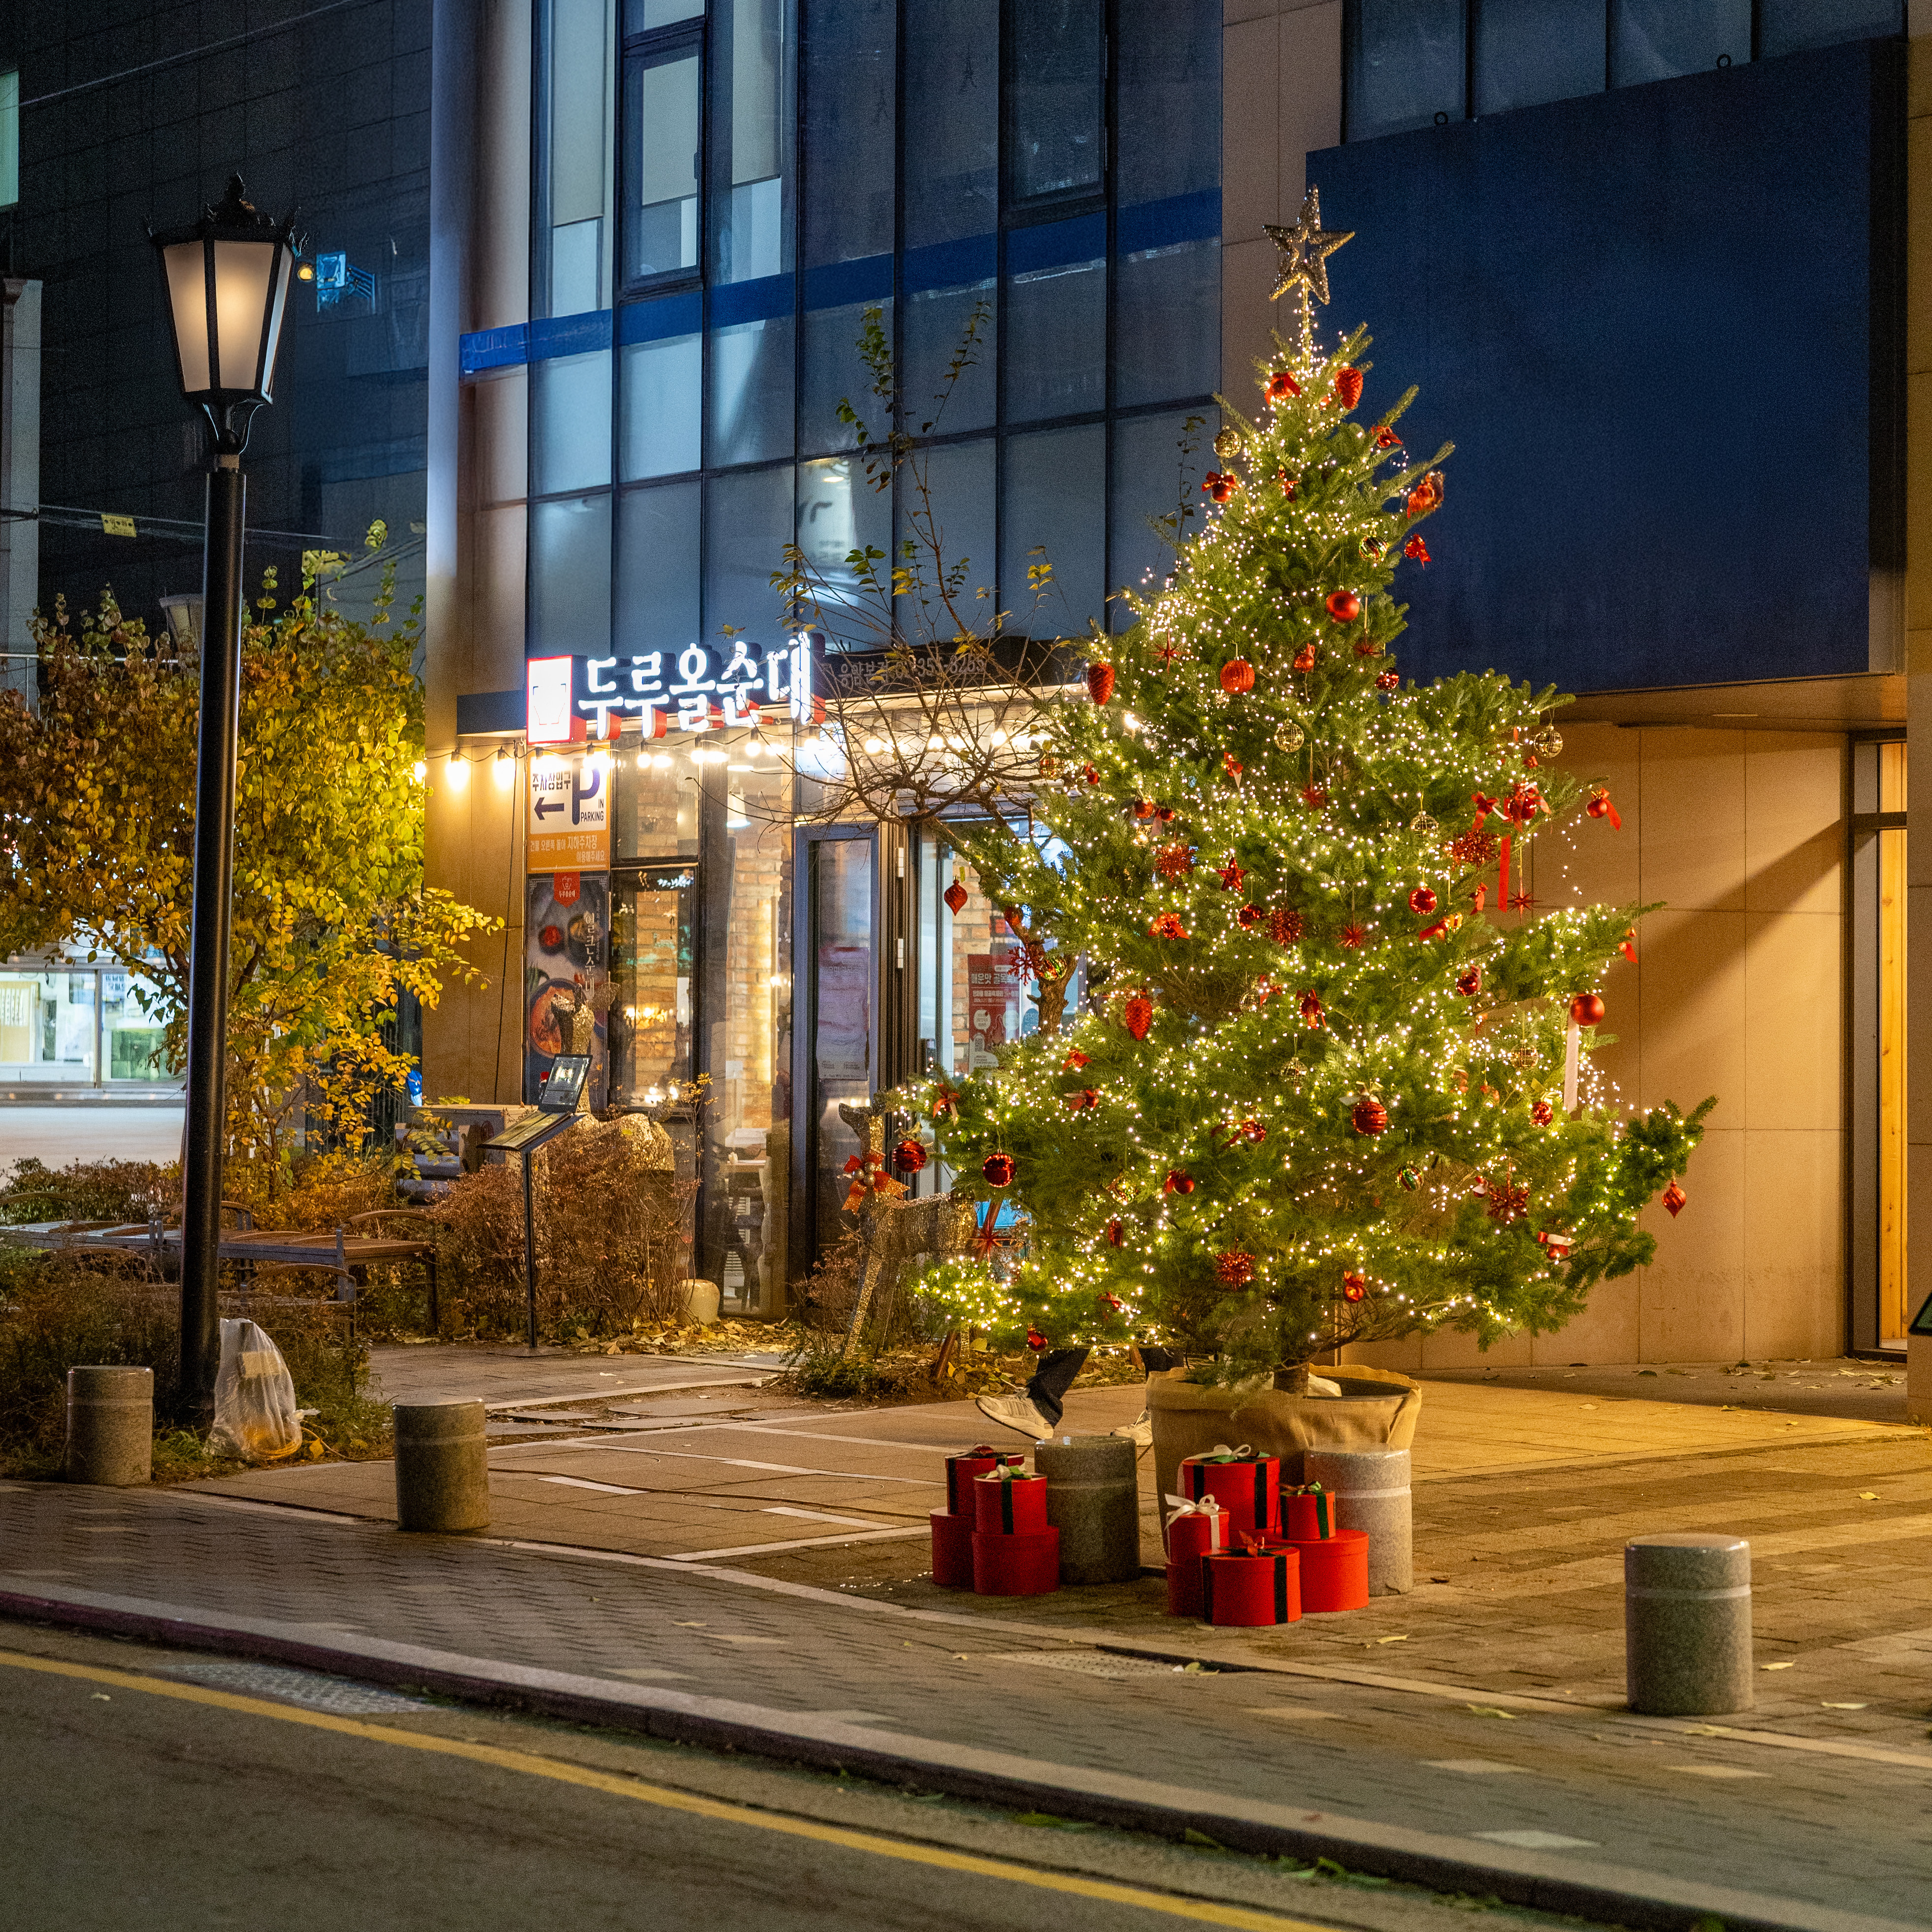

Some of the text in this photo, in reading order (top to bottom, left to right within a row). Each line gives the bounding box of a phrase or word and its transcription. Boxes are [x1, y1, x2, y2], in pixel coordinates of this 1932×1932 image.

[578, 631, 811, 740] 두루올순대
[532, 771, 571, 792] 주차장입구
[572, 758, 600, 825] P
[598, 798, 604, 809] IN
[581, 811, 604, 822] PARKING
[530, 840, 540, 852] 건물
[541, 839, 555, 851] 오른쪽
[567, 835, 597, 850] 지하주차장
[971, 973, 991, 984] 매운맛
